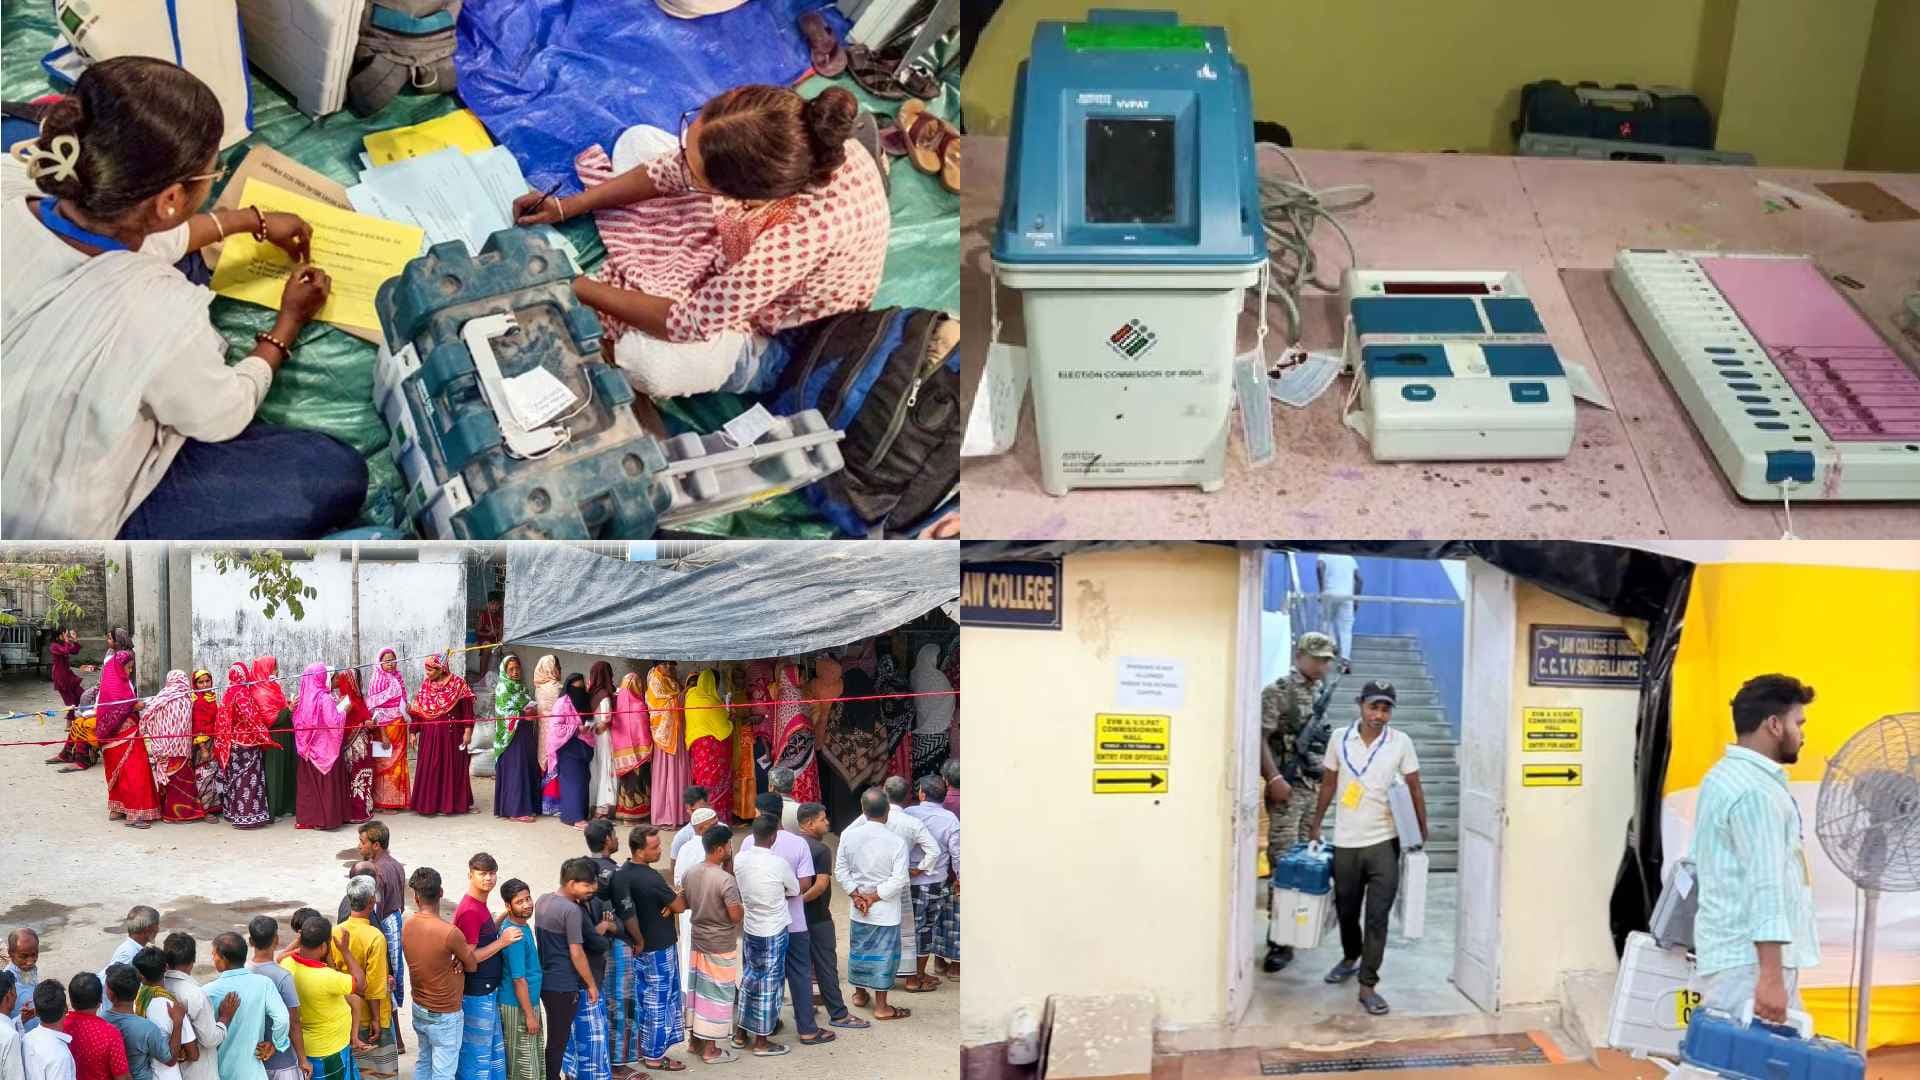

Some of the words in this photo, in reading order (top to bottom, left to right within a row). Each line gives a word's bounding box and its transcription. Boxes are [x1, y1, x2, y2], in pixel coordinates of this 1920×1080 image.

[1058, 369, 1103, 379] ELECTION
[1103, 369, 1162, 379] COMMISSION
[1164, 369, 1177, 378] OF
[1178, 368, 1203, 378] INDIA
[960, 572, 984, 607] AW
[988, 573, 1053, 610] COLLEGE
[1576, 637, 1608, 655] COLLEGE
[1577, 658, 1638, 676] SURVEILLANCE
[1119, 753, 1133, 761] FOR
